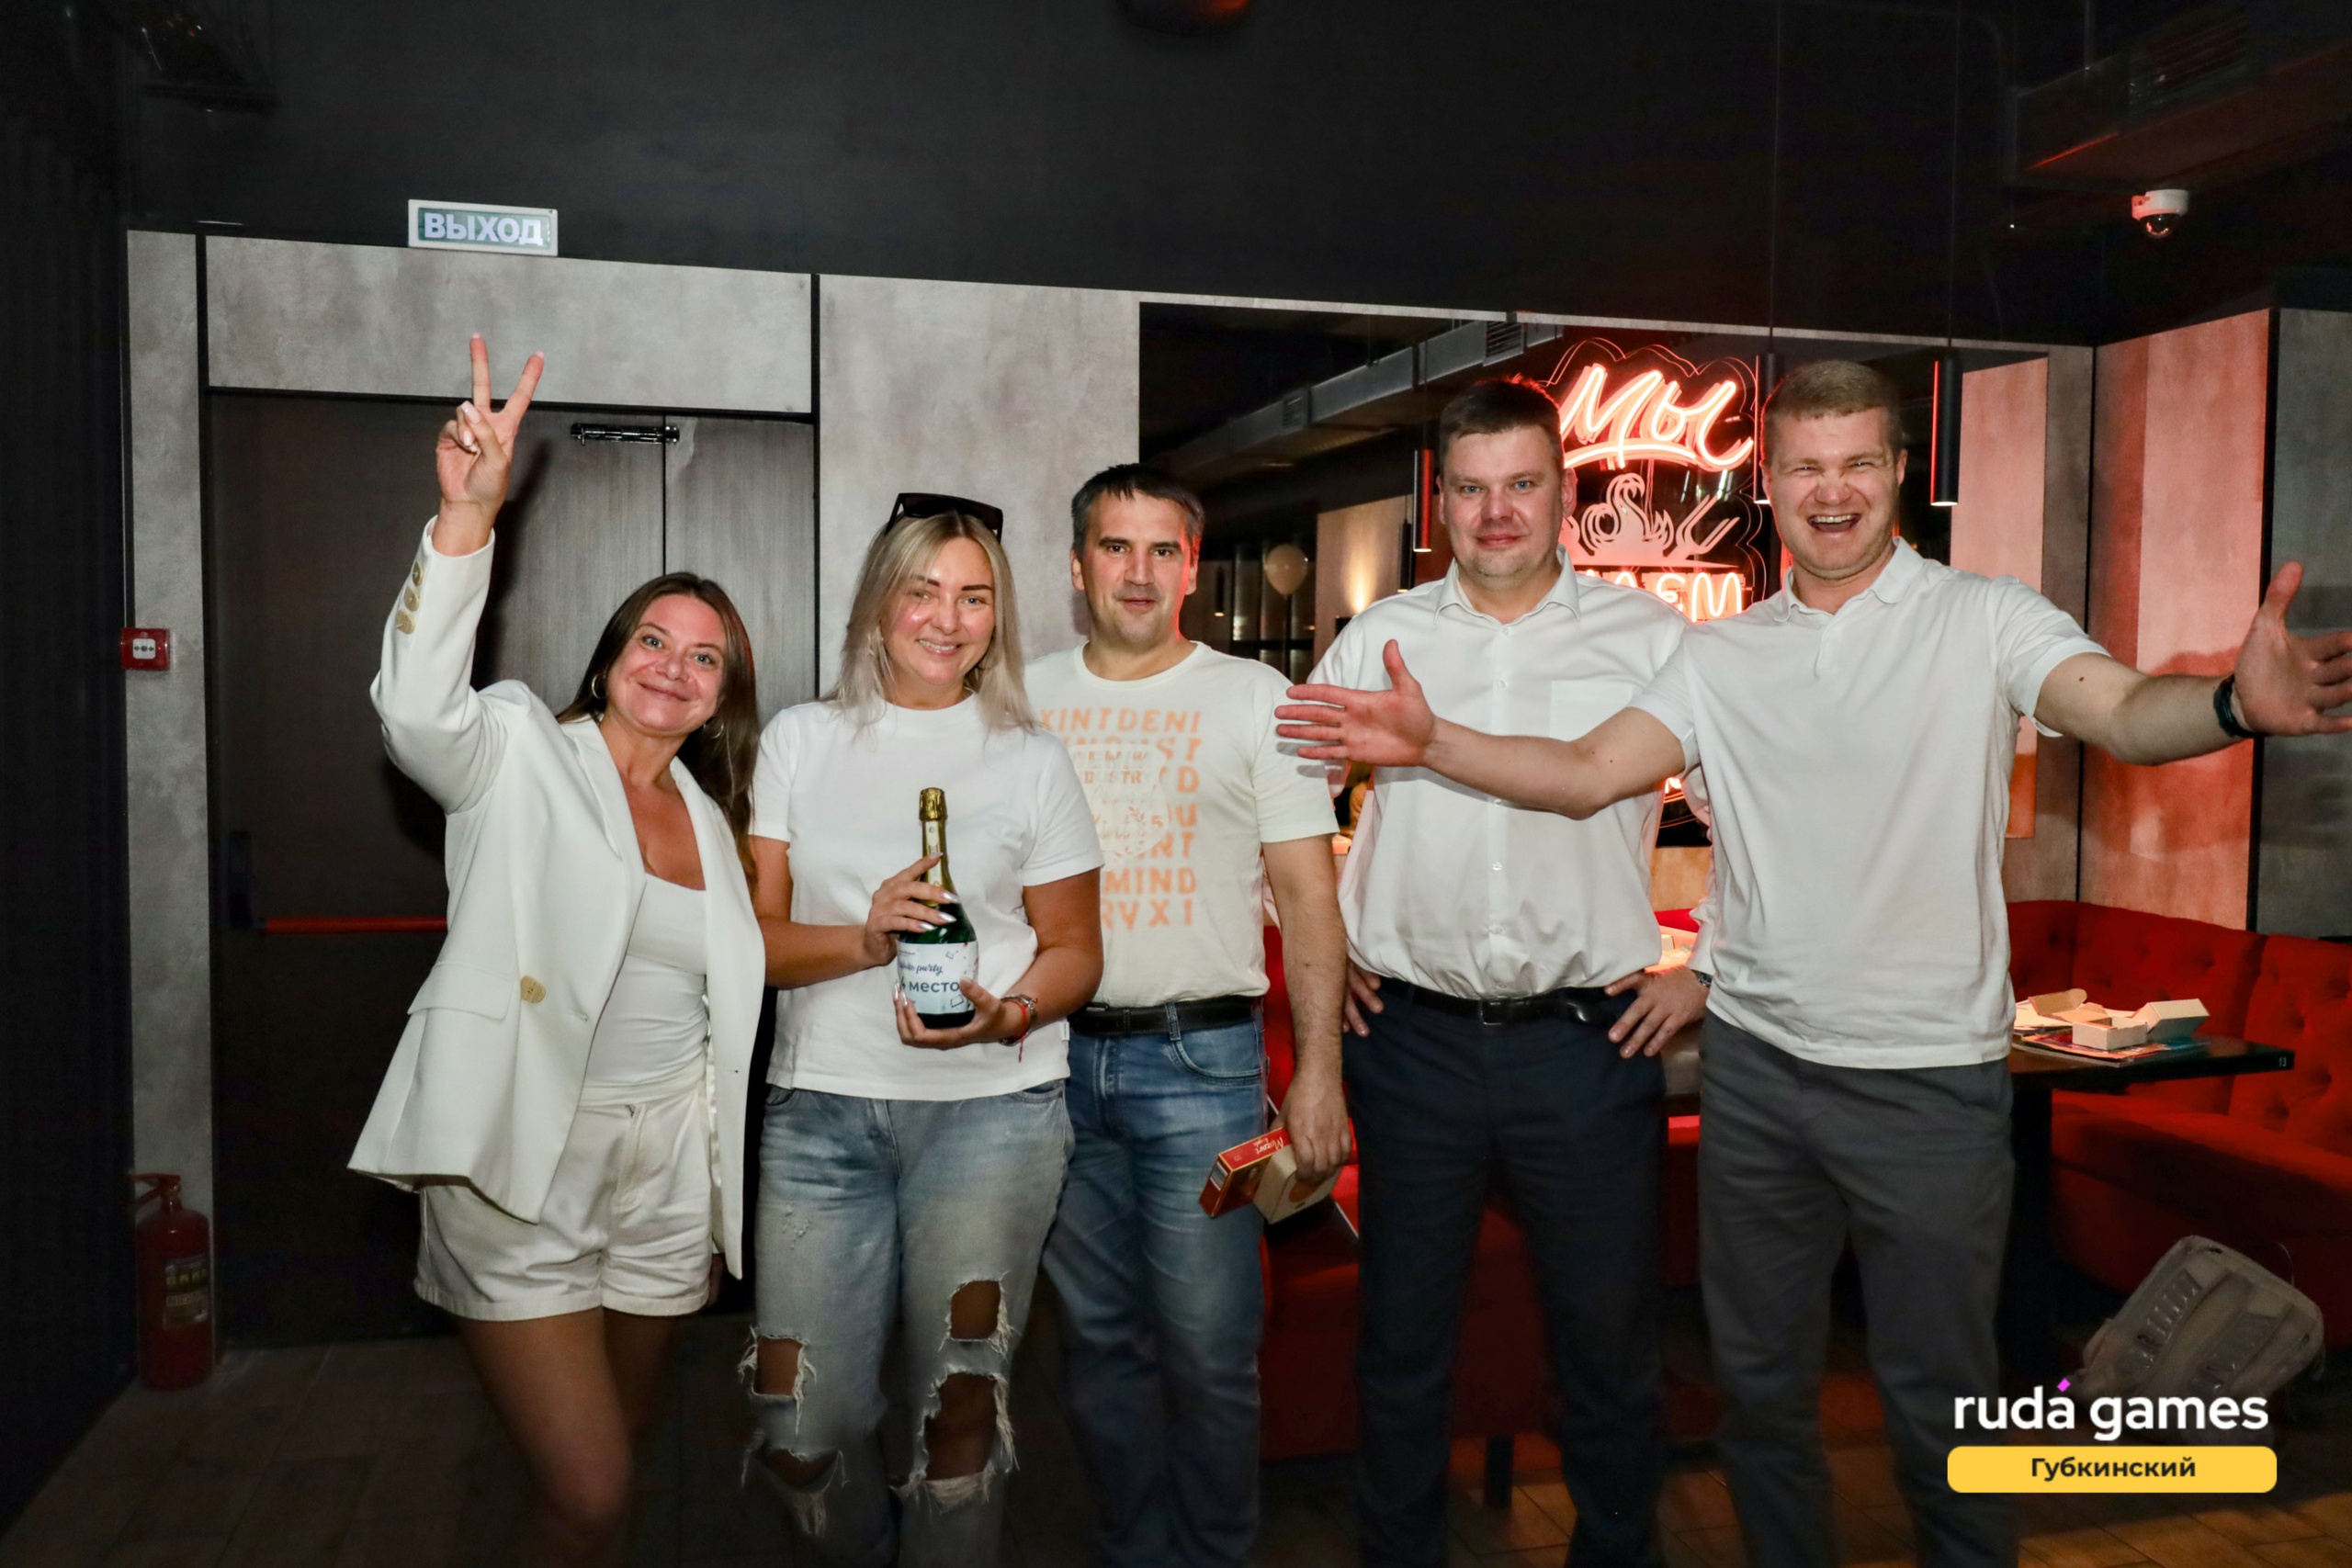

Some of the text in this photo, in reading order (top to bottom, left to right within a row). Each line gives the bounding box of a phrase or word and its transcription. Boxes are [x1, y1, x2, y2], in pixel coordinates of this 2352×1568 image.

[424, 212, 544, 246] ВЫХОД
[1559, 363, 1754, 471] Мы
[1103, 867, 1197, 895] MIND
[1255, 1136, 1284, 1156] Mozart
